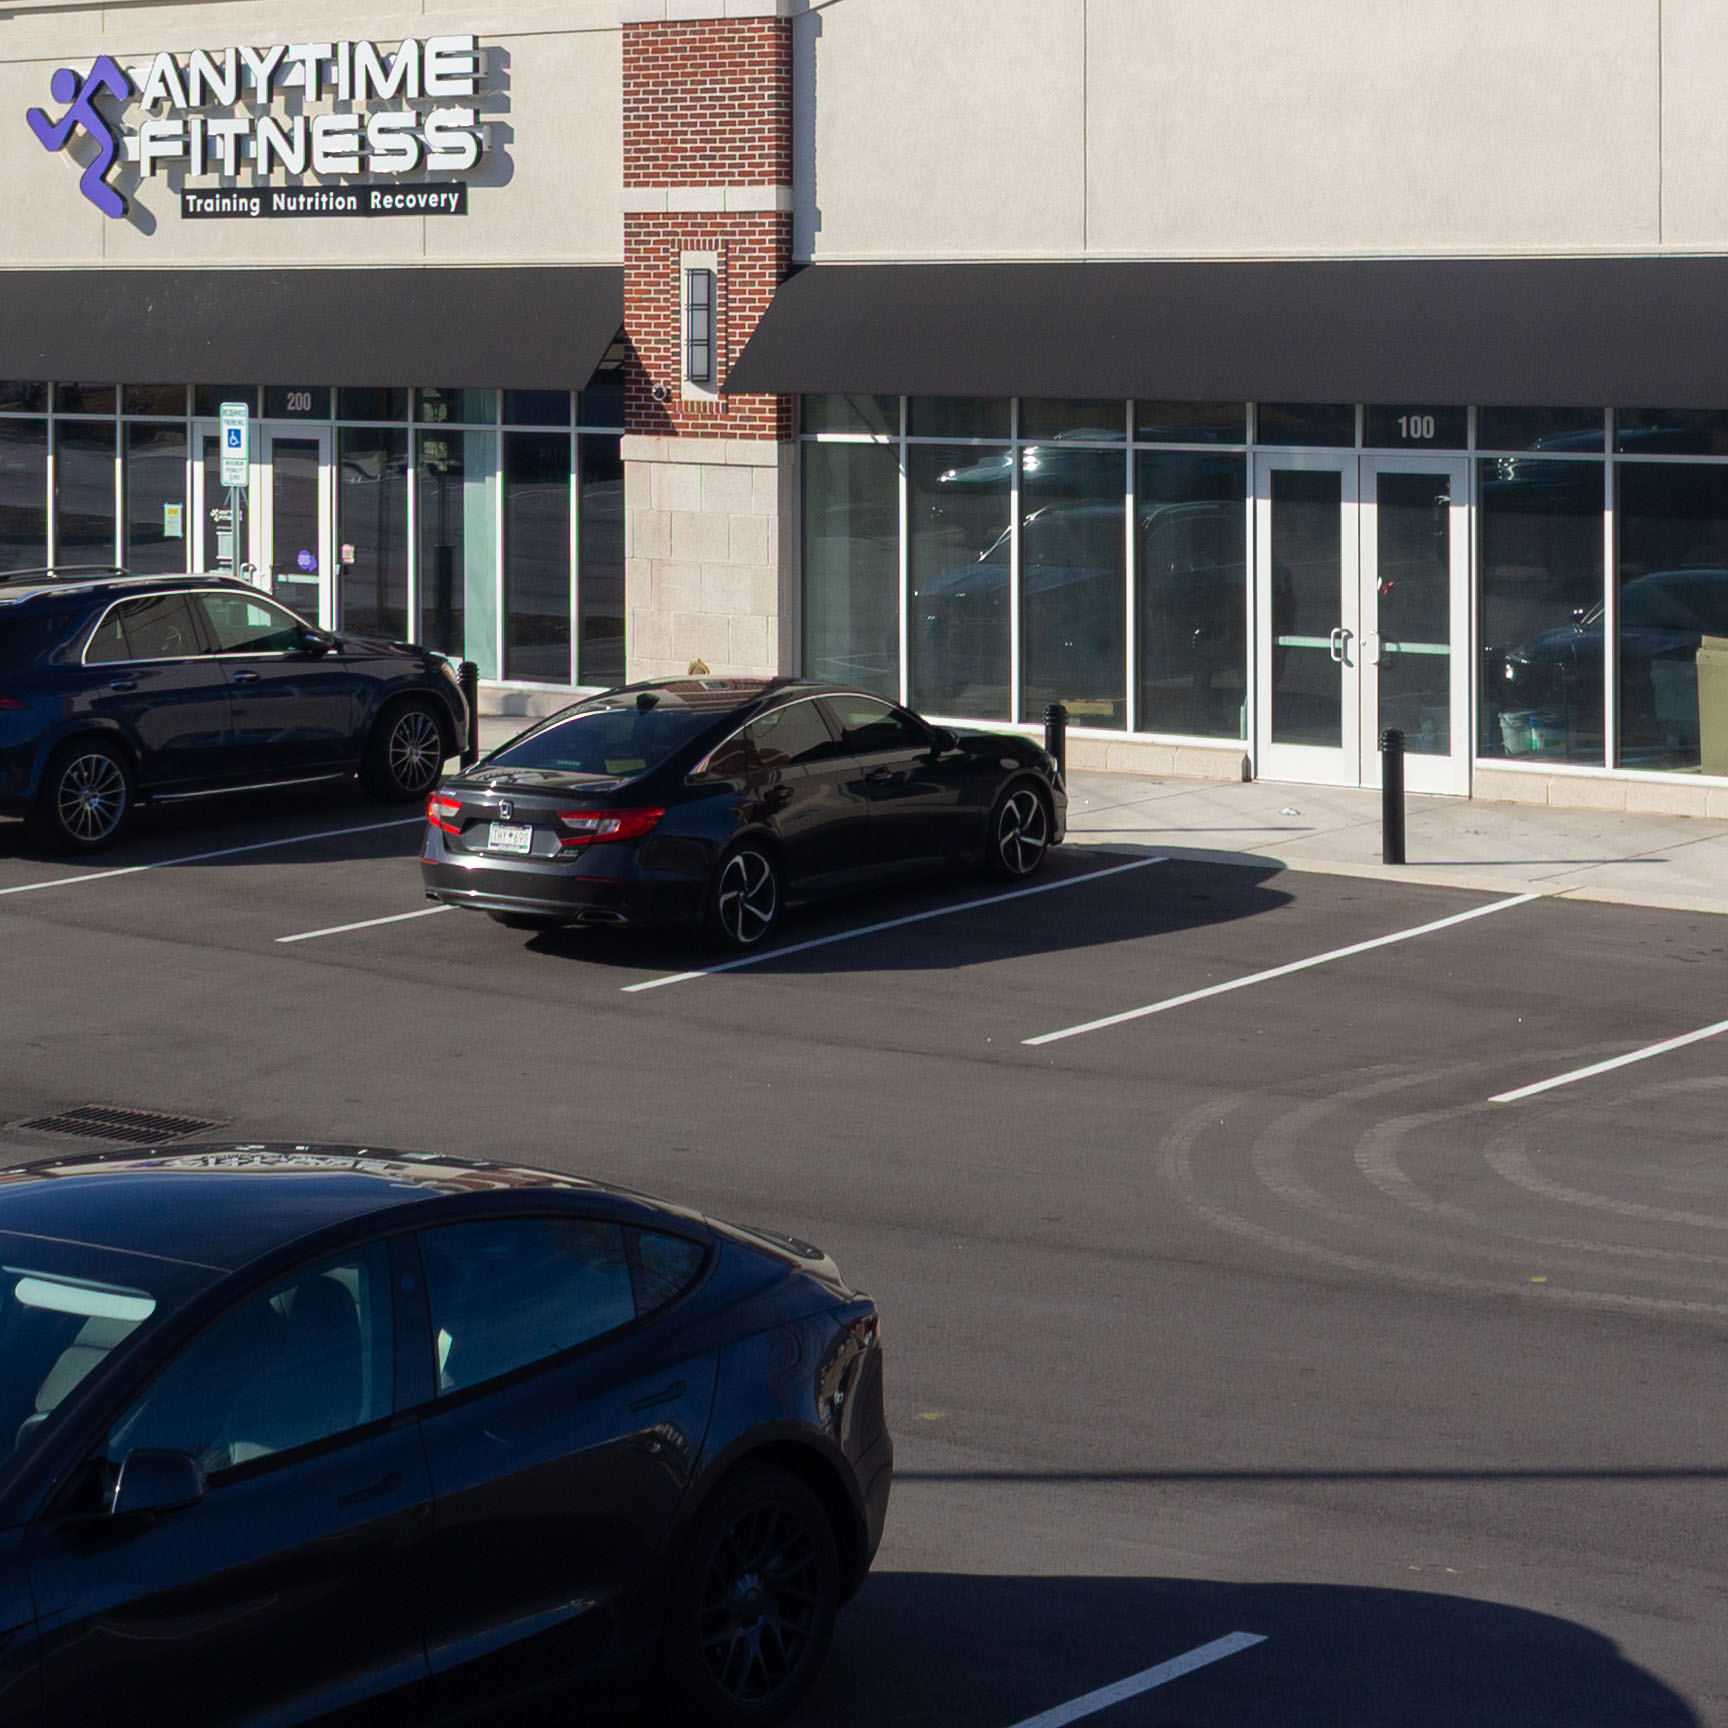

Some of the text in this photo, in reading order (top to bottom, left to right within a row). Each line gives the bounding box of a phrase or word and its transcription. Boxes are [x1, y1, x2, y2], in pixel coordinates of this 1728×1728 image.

[140, 34, 475, 110] ANYTIME
[140, 108, 477, 177] FITNESS
[185, 190, 460, 216] Training Nutrition Recovery
[287, 392, 312, 411] 200
[1398, 415, 1434, 439] 100
